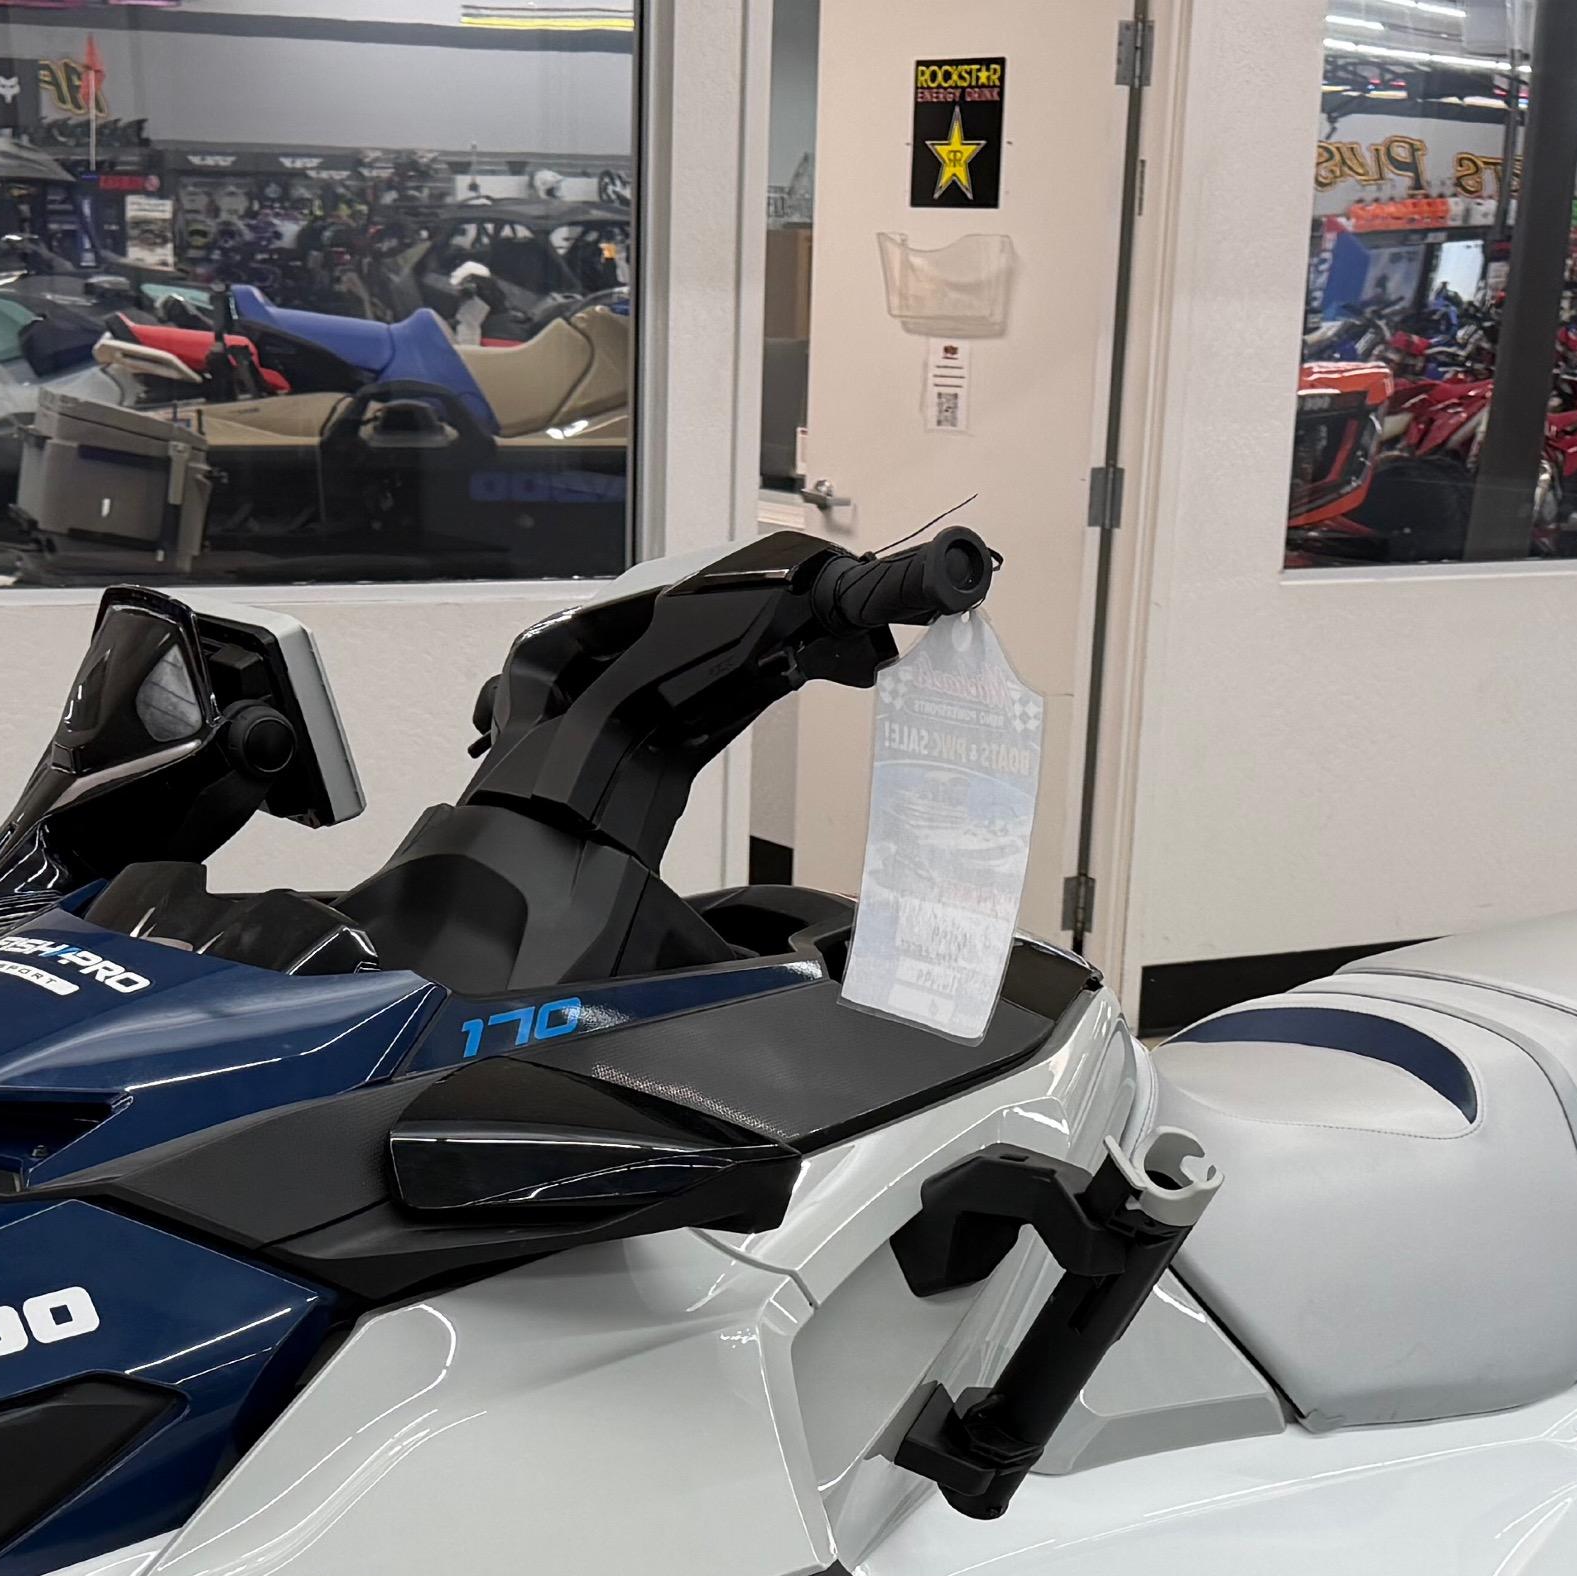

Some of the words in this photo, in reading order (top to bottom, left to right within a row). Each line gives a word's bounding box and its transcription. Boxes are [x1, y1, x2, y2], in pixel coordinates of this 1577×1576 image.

[917, 88, 962, 102] ENERGY
[964, 87, 1001, 101] DRINK
[461, 997, 581, 1058] 170
